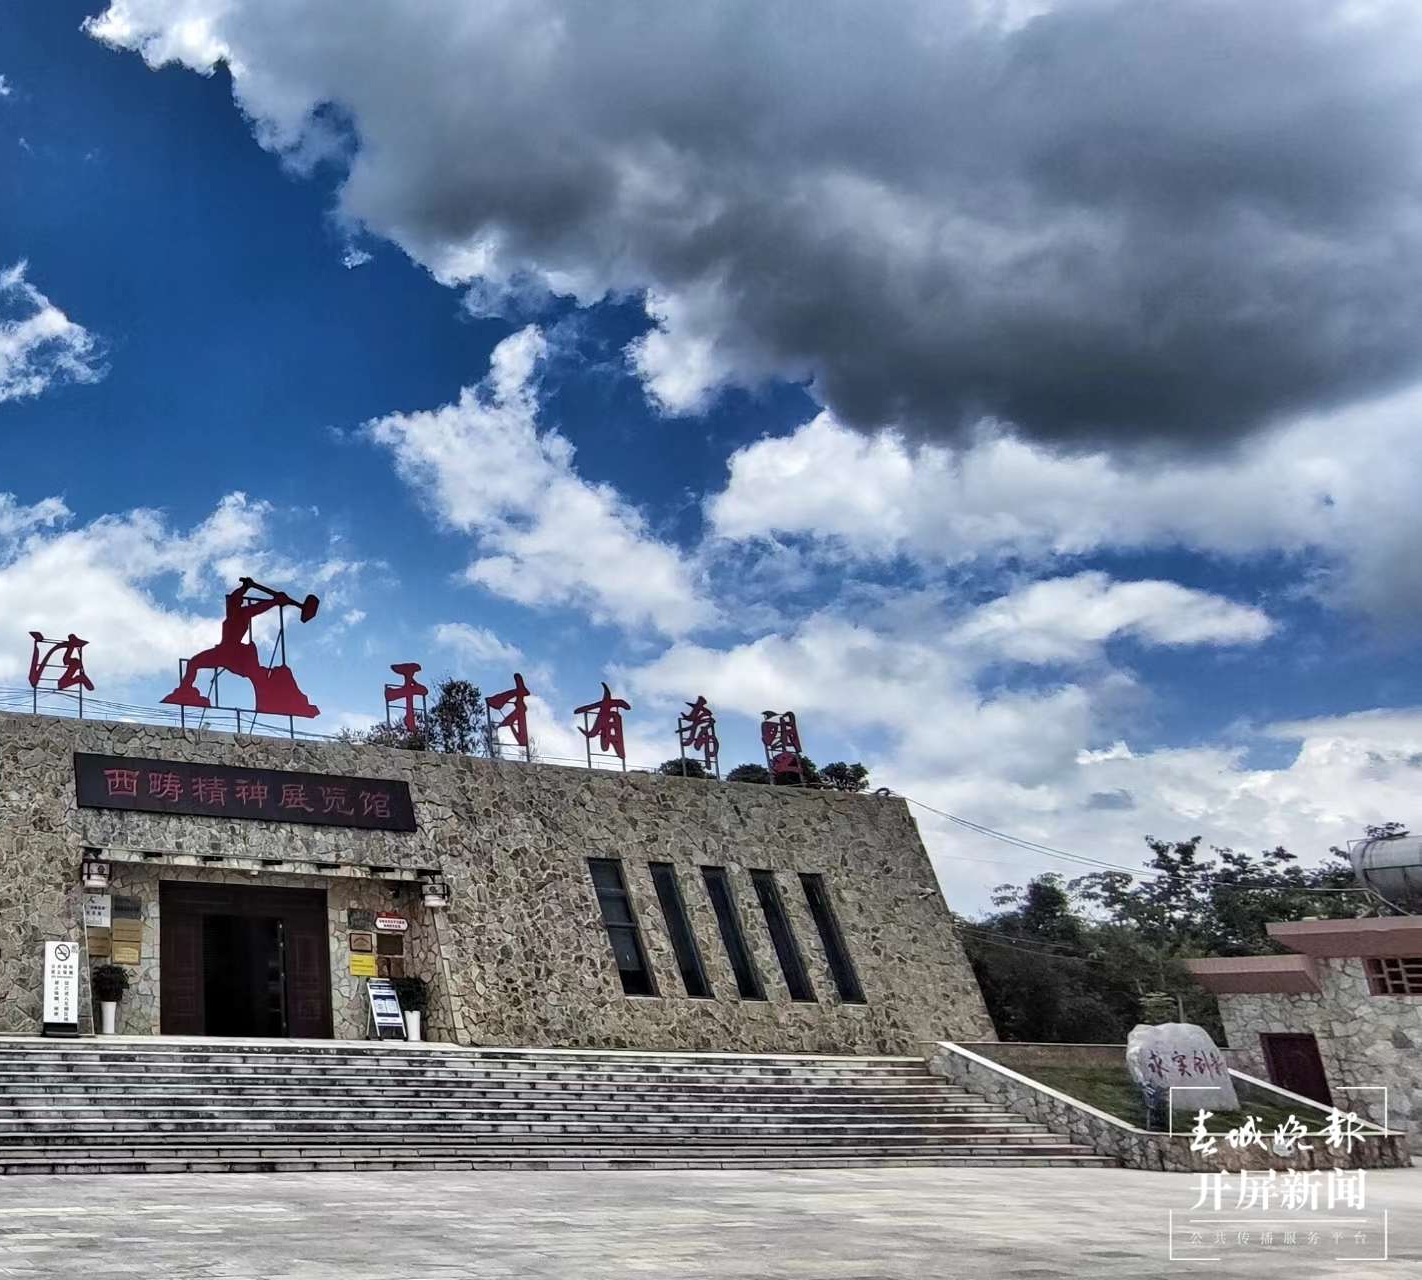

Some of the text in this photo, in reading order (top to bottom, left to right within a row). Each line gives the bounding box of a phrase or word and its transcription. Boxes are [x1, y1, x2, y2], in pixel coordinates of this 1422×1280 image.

[103, 767, 392, 820] 西畴精神展览馆
